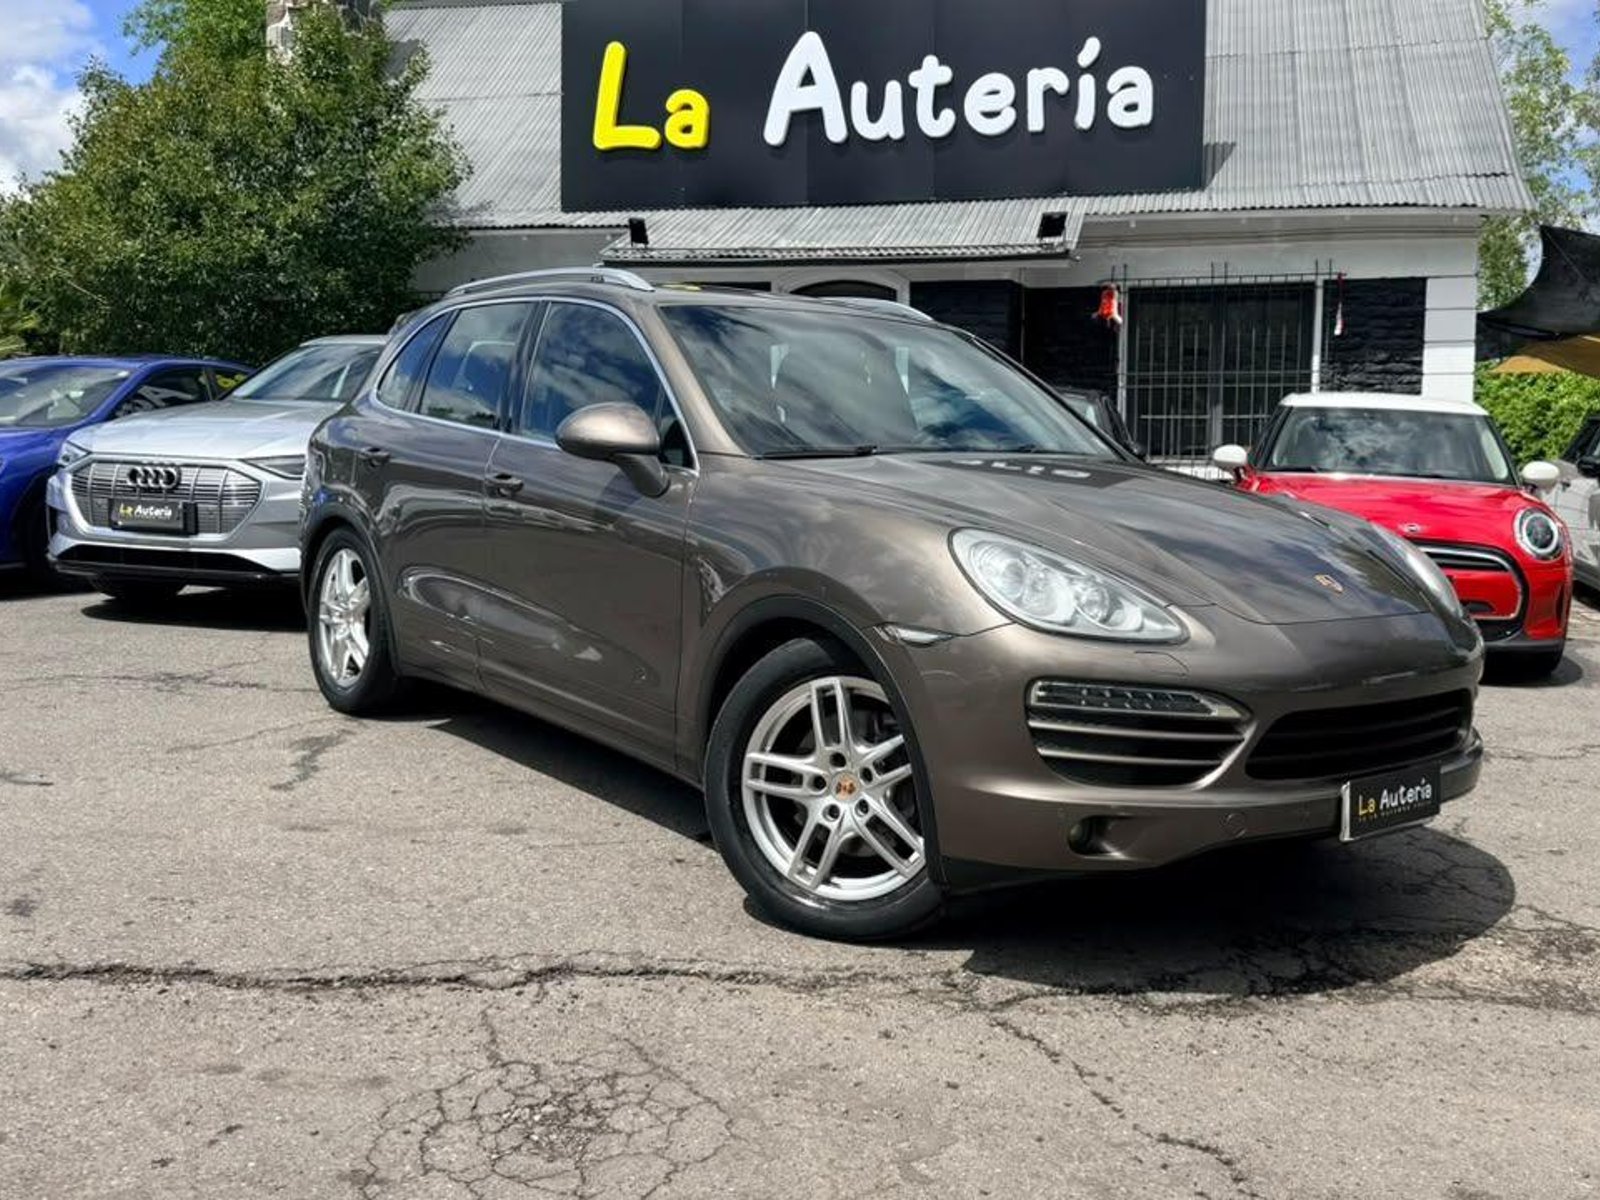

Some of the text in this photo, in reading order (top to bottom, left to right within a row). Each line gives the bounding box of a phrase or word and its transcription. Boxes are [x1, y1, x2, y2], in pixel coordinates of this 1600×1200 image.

[594, 30, 1155, 151] La Autería
[1358, 794, 1376, 816] La
[1379, 777, 1433, 811] Autería
